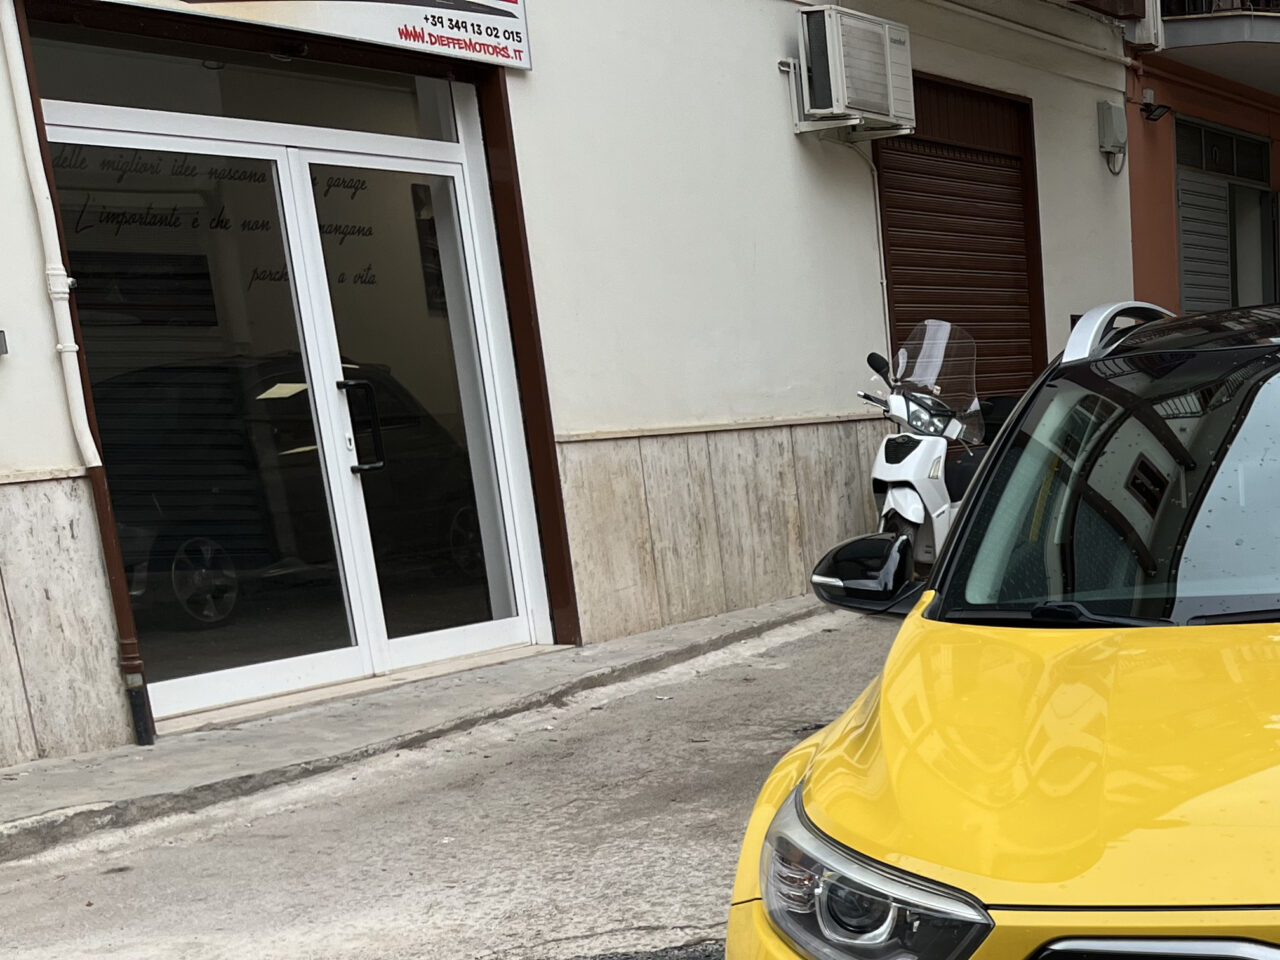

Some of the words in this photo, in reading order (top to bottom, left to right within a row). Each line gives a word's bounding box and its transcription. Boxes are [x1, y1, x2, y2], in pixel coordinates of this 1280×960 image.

[398, 24, 524, 61] WWW.DIEFFEMOTORS.IT
[424, 14, 444, 28] +39
[448, 18, 468, 33] 349
[470, 23, 483, 36] 13
[485, 25, 500, 39] 02
[503, 29, 522, 43] 015
[99, 149, 163, 184] migliori
[171, 154, 198, 178] idee
[207, 167, 267, 184] nascono
[323, 176, 368, 200] garage
[75, 192, 182, 237] L'importante
[209, 205, 232, 231] che
[241, 218, 272, 233] non
[353, 263, 377, 286] vita
